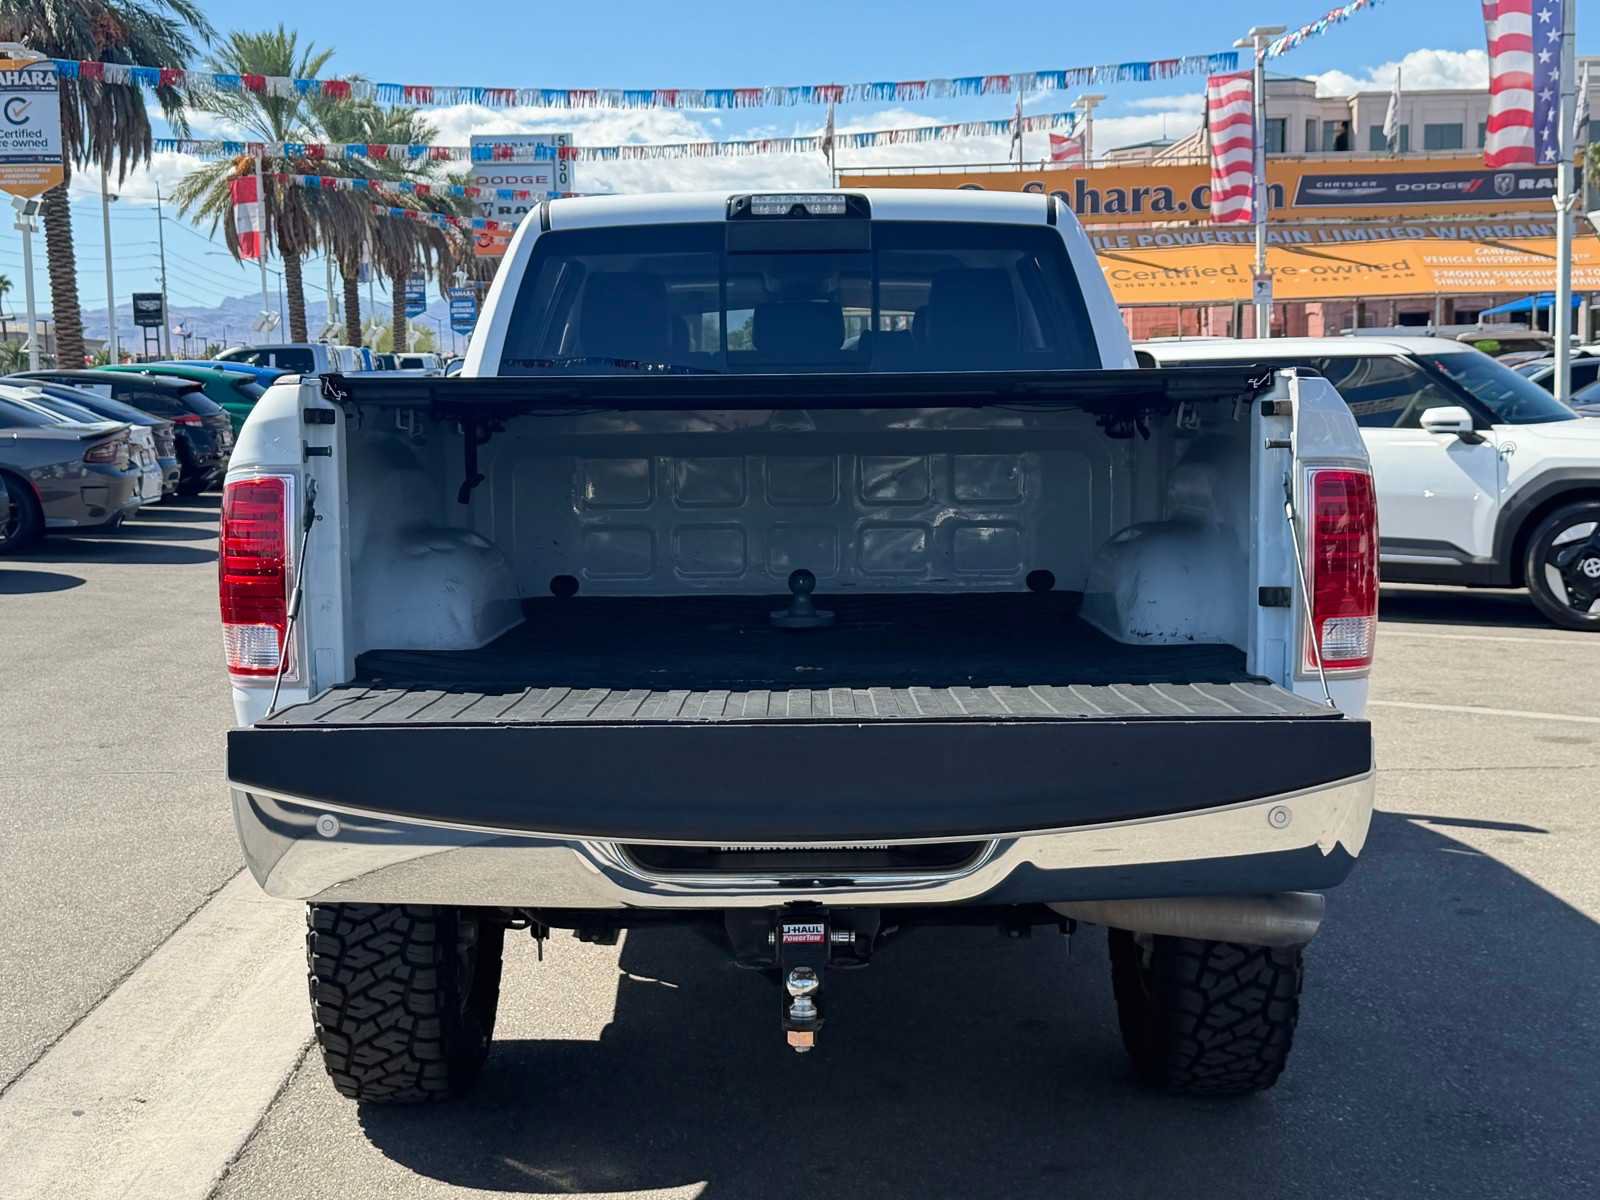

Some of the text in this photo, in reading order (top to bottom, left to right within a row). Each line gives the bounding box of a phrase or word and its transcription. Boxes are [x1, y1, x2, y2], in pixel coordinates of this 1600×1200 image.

[475, 176, 549, 184] DODGE
[1518, 178, 1557, 189] RA
[1395, 182, 1472, 192] DODGE
[498, 205, 534, 215] RA
[1318, 226, 1425, 243] LIMITED
[1430, 223, 1577, 241] WARRANT
[1111, 264, 1239, 281] Certified
